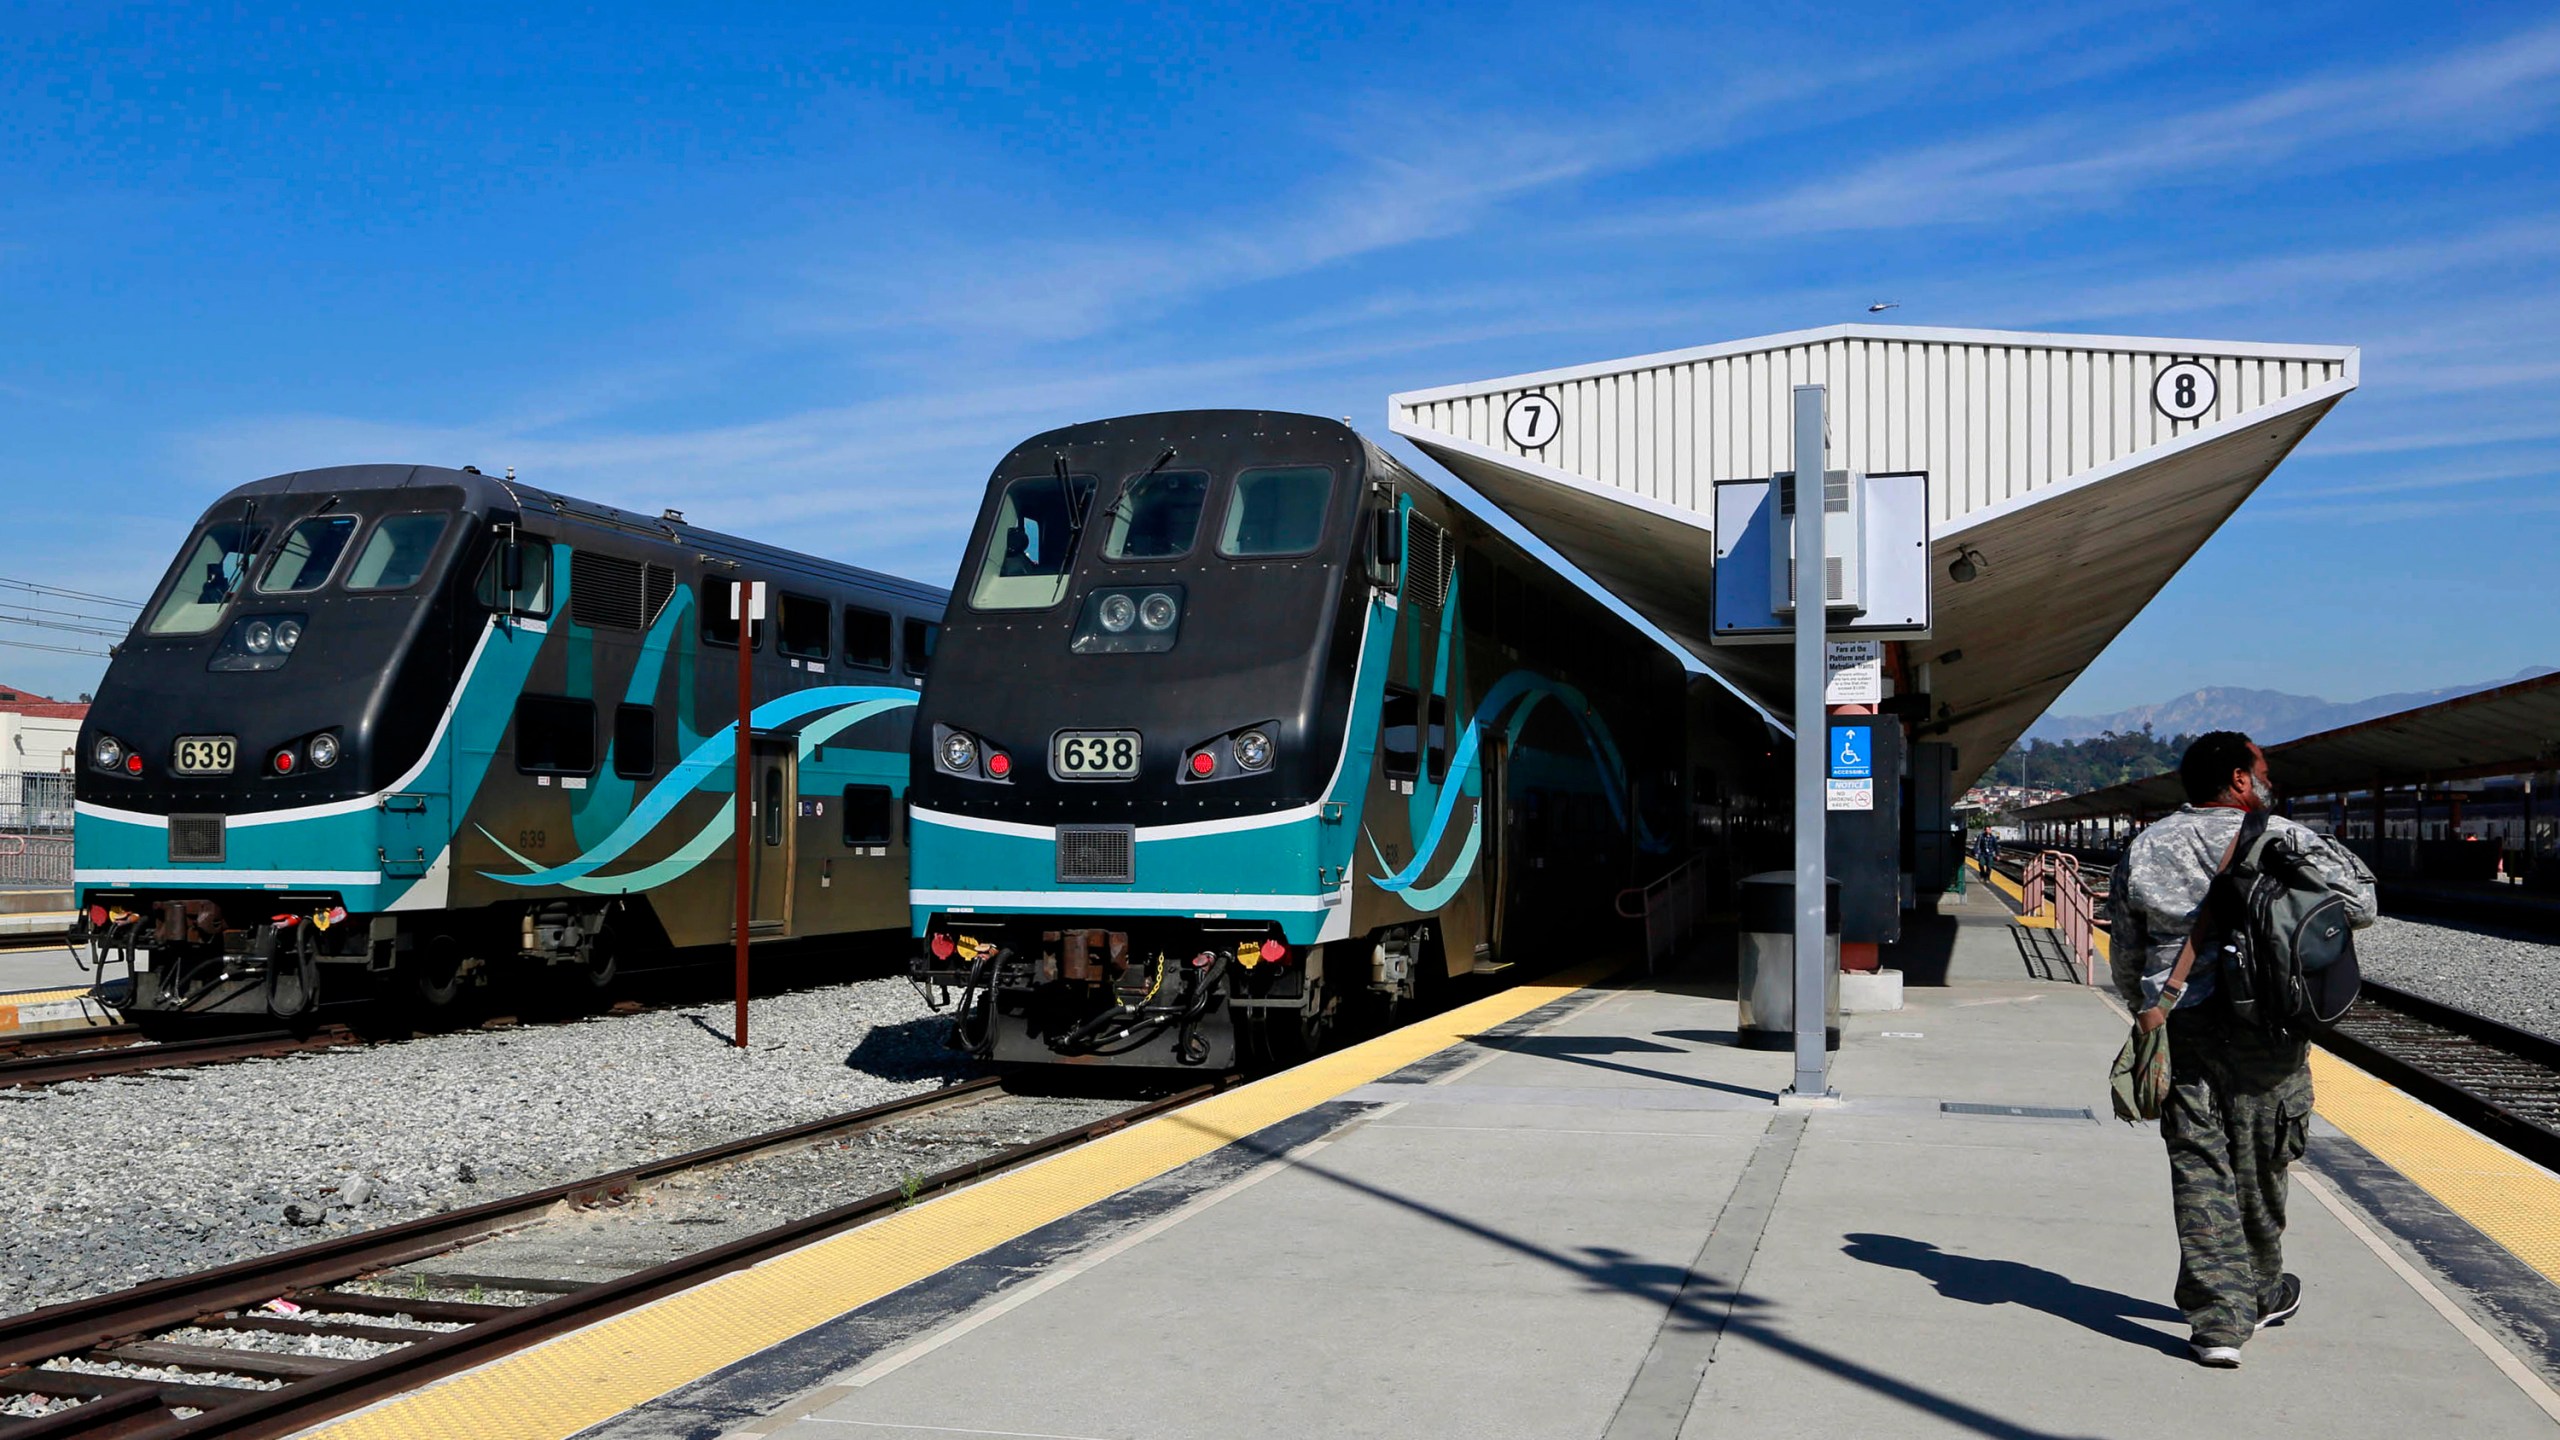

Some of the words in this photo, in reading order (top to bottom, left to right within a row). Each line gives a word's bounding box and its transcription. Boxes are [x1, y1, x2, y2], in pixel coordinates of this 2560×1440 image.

[2175, 373, 2196, 409] 8
[1524, 405, 1541, 437] 7
[182, 742, 232, 768] 639
[1064, 738, 1133, 770] 638
[1834, 781, 1864, 789] NOTICE
[520, 830, 546, 848] 639
